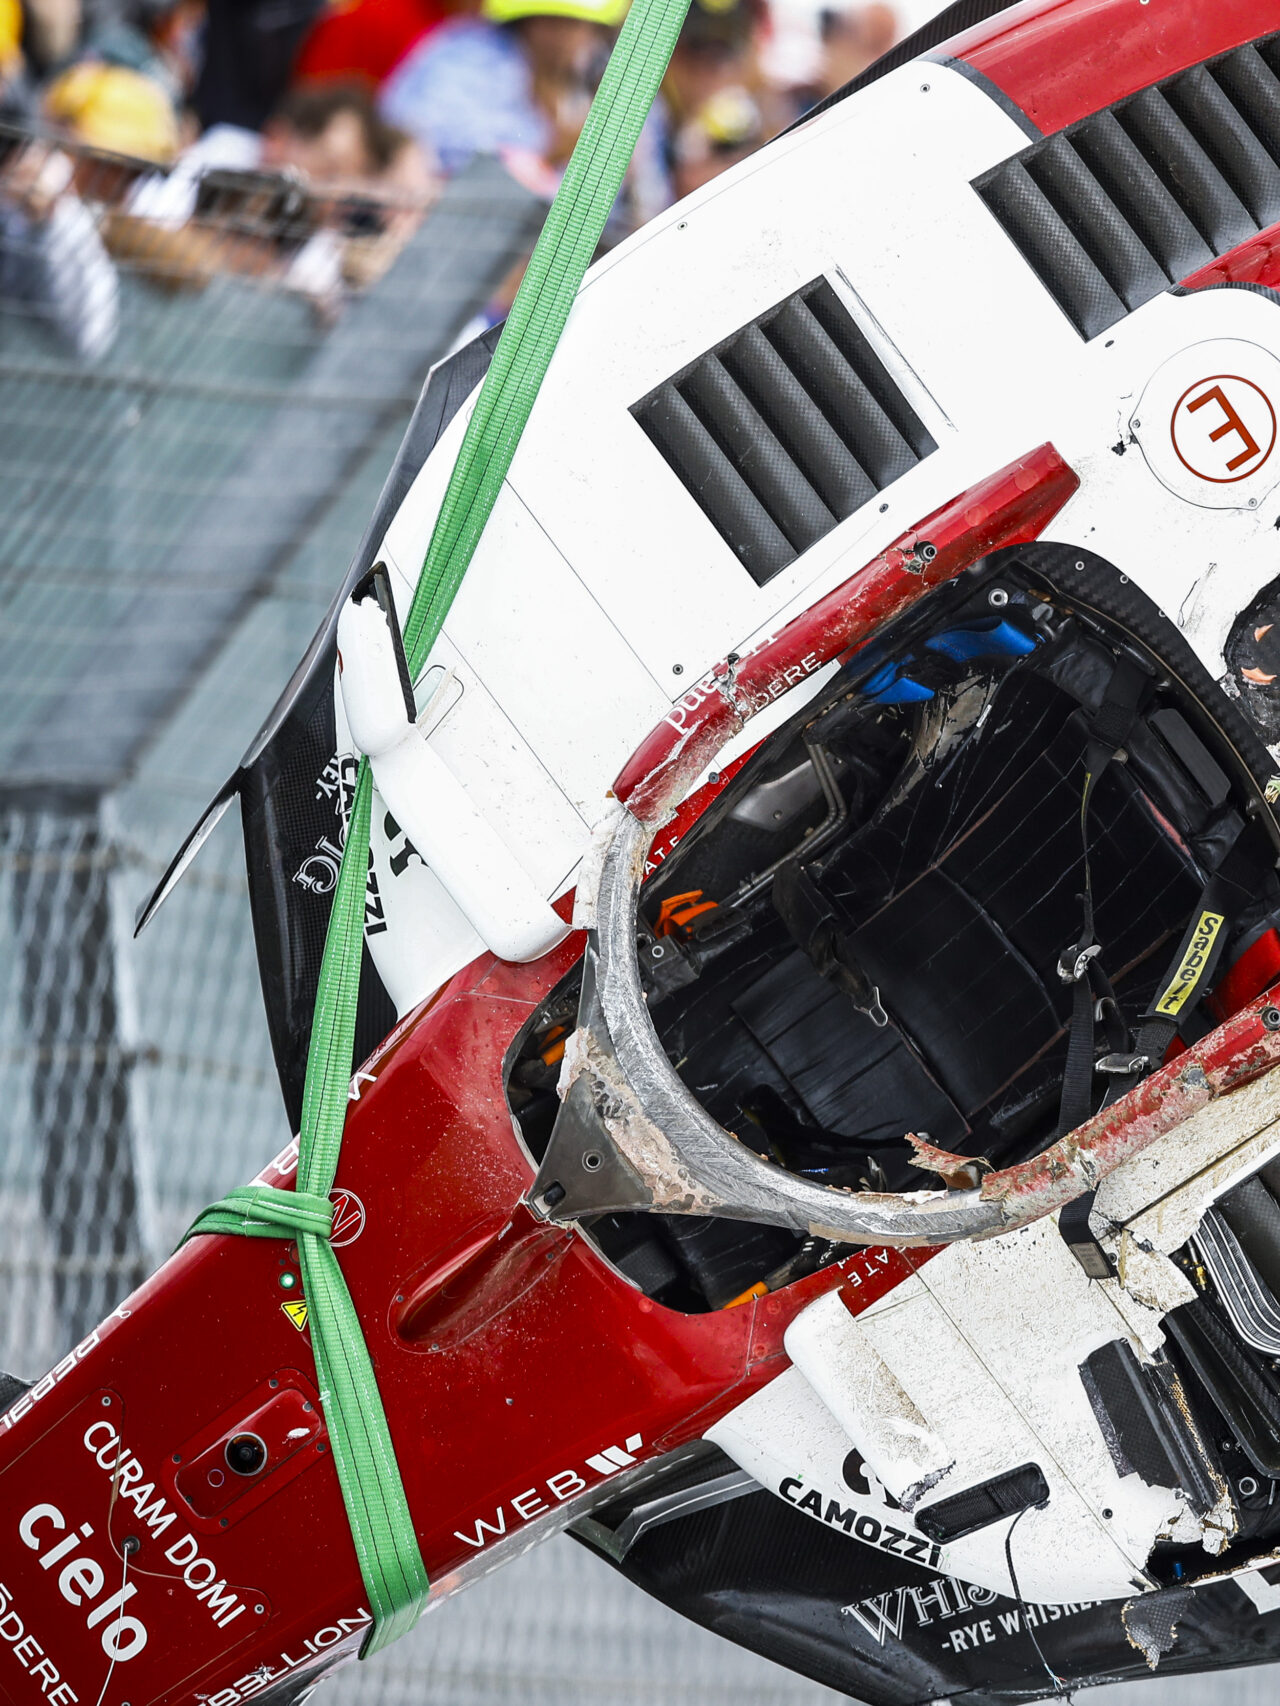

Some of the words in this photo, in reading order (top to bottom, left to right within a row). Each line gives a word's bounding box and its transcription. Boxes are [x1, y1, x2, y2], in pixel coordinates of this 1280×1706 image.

[1186, 384, 1261, 472] E
[1162, 916, 1220, 1011] Sabelt
[83, 1420, 177, 1540] CURAM
[164, 1533, 247, 1629] DOMI
[778, 1476, 942, 1569] CAMOZZI
[18, 1502, 149, 1663] cielo
